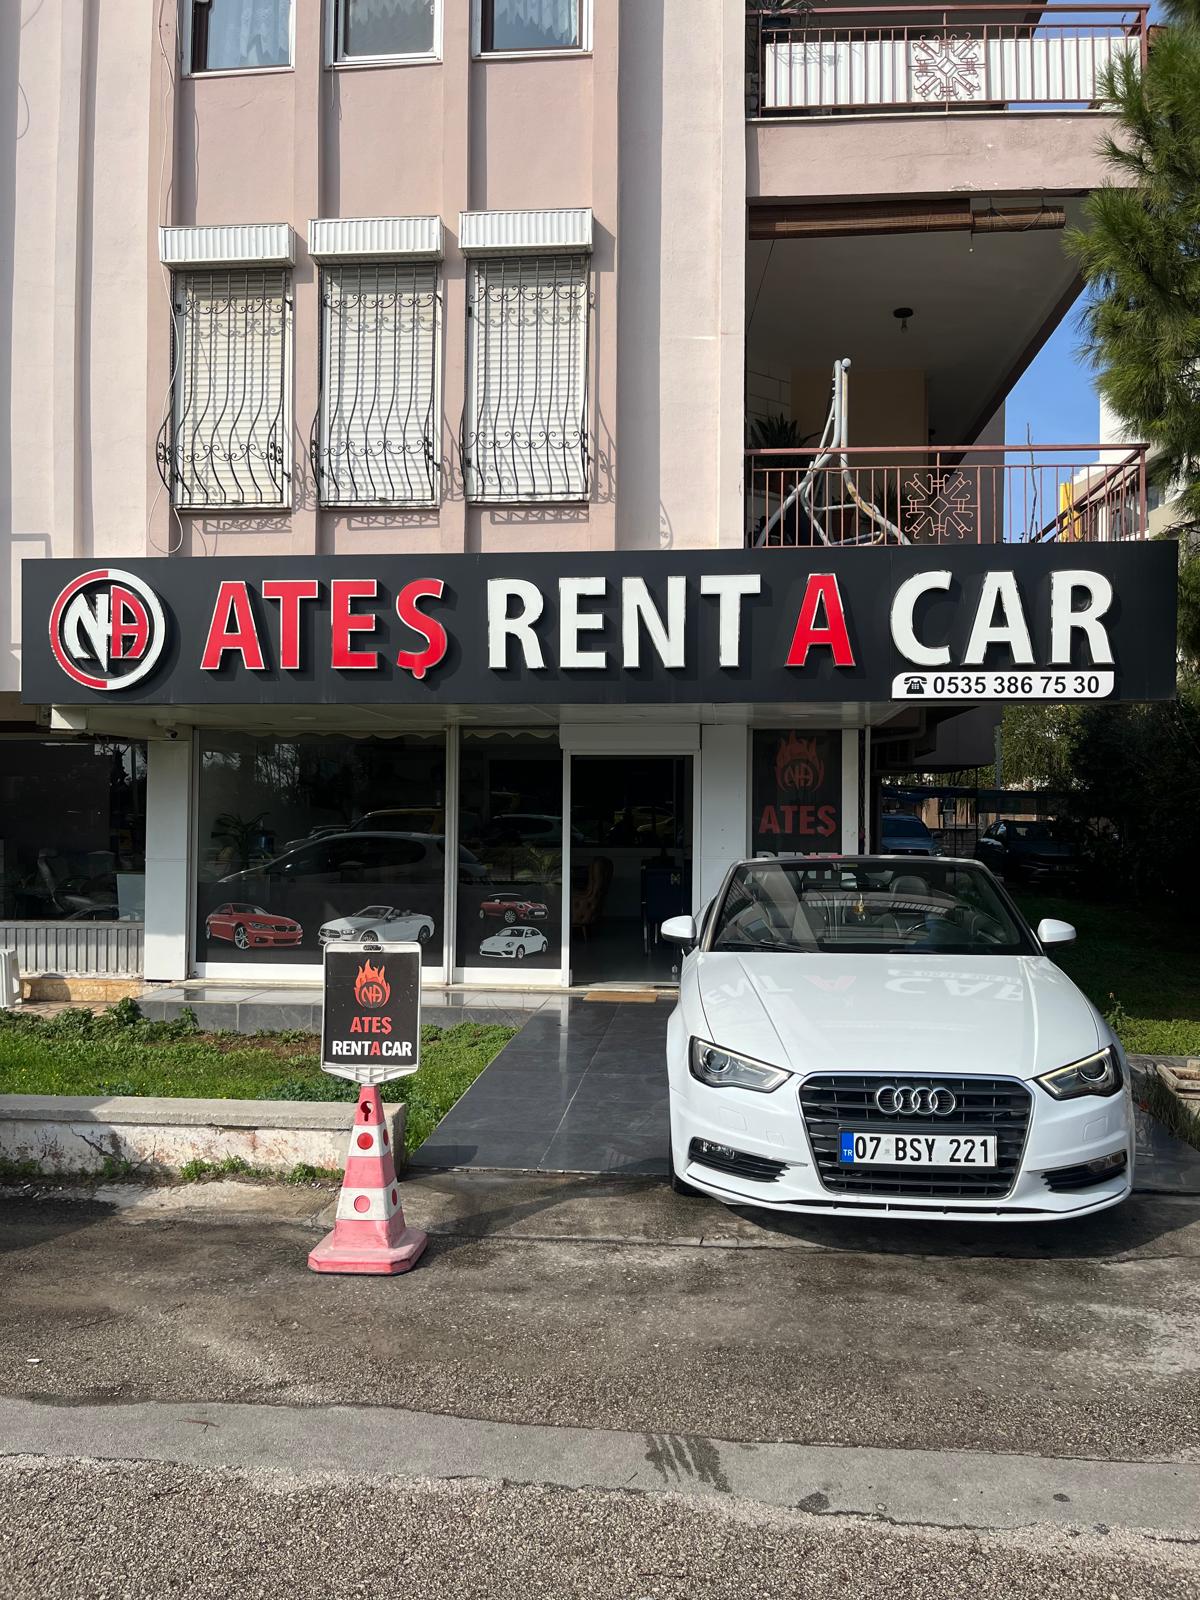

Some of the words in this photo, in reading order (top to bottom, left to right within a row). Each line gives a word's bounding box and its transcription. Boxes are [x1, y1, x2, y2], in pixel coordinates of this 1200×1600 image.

[200, 578, 448, 680] ATEŞ
[487, 574, 761, 669] RENT
[784, 573, 856, 667] A
[890, 570, 1115, 667] CAR
[933, 676, 987, 694] 0535
[993, 676, 1033, 694] 386
[1040, 676, 1067, 694] 75
[1073, 676, 1100, 694] 30
[843, 1148, 853, 1157] TR
[855, 1136, 881, 1160] 07
[895, 1137, 936, 1162] BSY
[950, 1138, 988, 1163] 221
